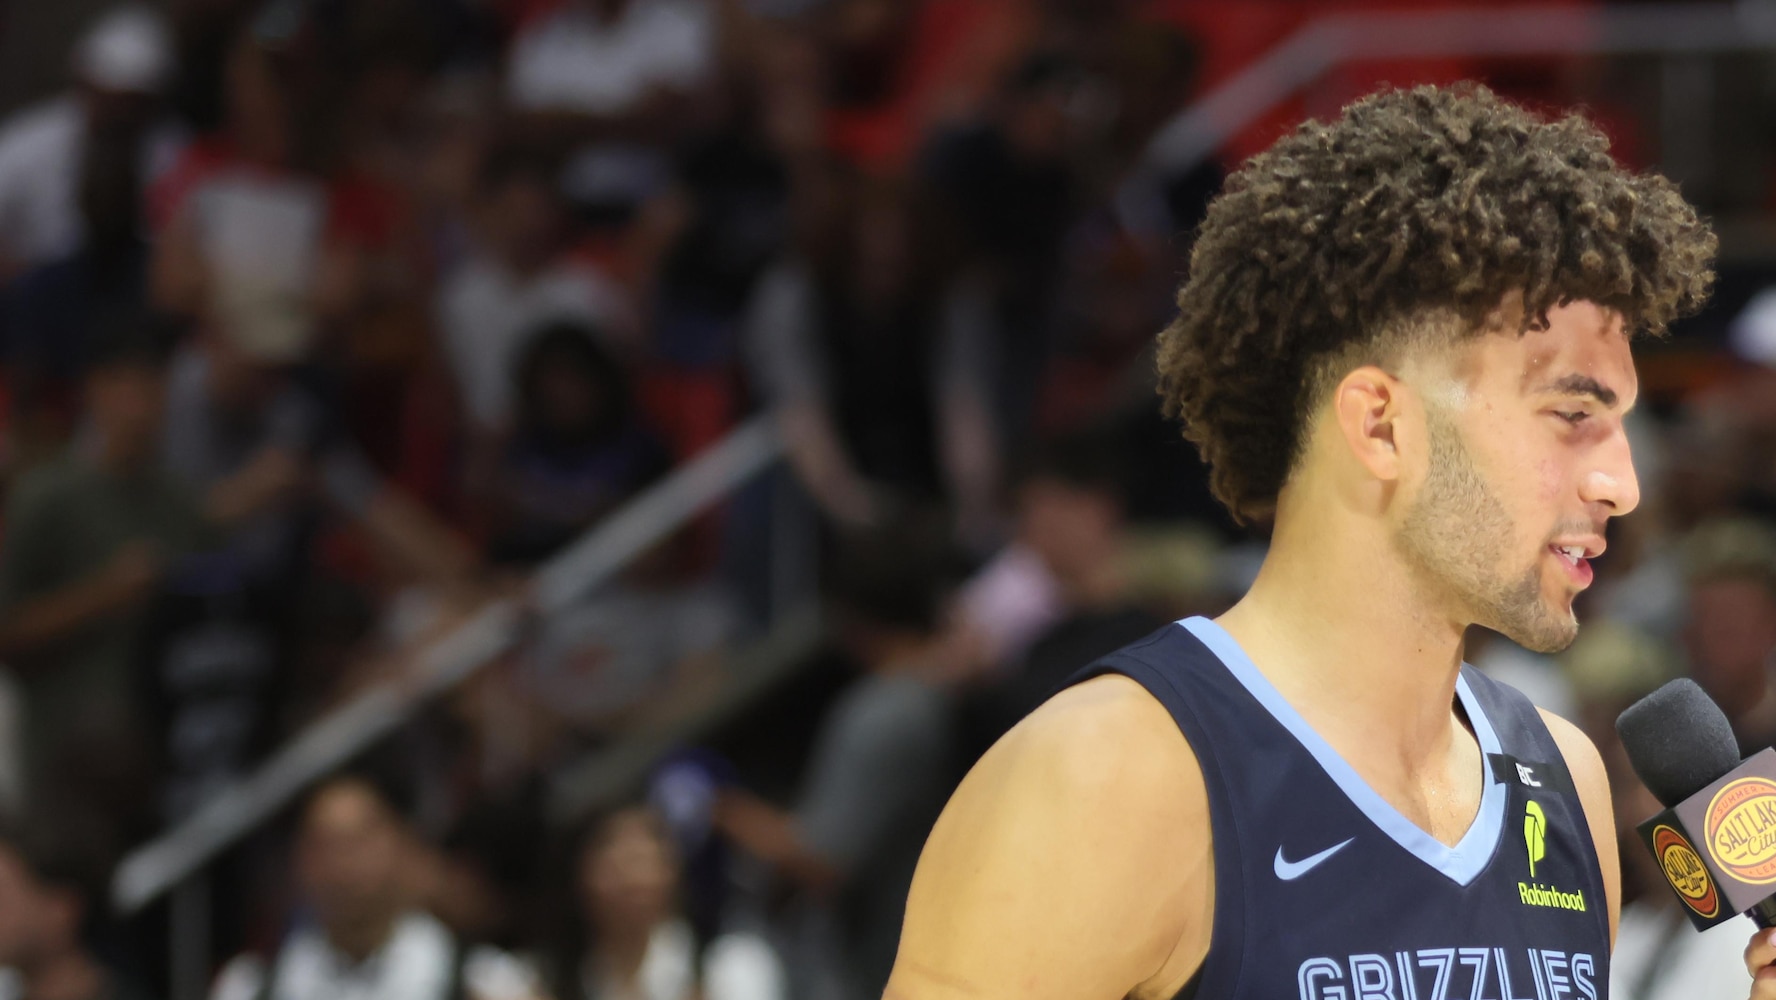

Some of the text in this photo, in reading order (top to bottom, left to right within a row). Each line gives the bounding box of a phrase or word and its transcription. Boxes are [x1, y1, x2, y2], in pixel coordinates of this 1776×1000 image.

[1717, 785, 1758, 814] SUMMER
[1719, 811, 1751, 855] SALT
[1518, 882, 1586, 912] Robinhood
